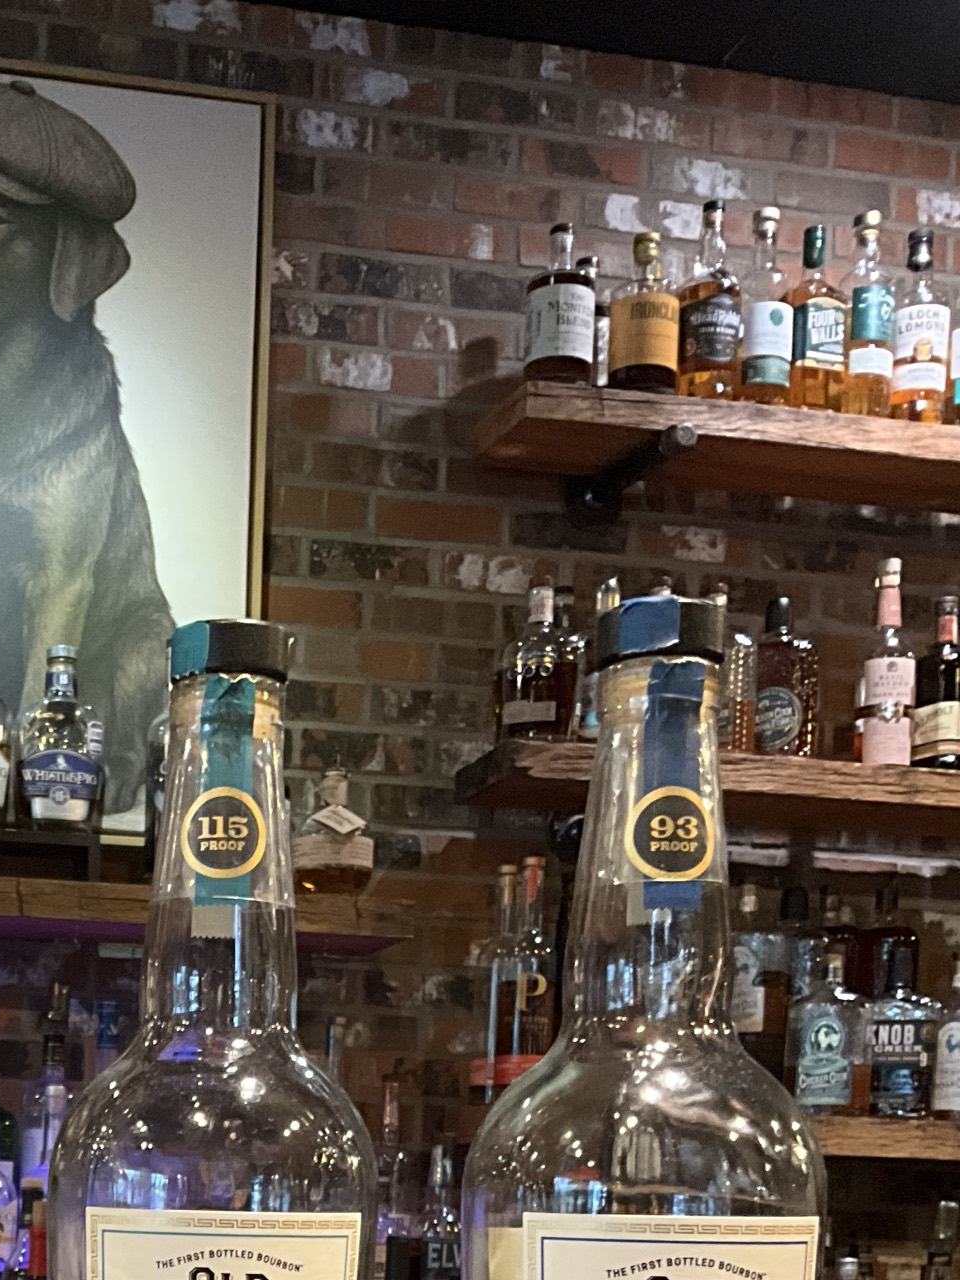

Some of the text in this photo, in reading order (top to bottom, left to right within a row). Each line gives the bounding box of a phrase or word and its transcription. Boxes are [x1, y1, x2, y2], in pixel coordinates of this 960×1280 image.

[548, 301, 595, 316] MONITO
[631, 301, 679, 322] IRONCLA
[809, 309, 836, 327] FOUR
[909, 309, 940, 321] LOCH
[810, 325, 844, 344] WALLS
[196, 815, 248, 840] 115
[650, 816, 698, 840] 93
[199, 839, 246, 852] PROOF
[649, 840, 698, 853] PROOF
[518, 973, 547, 1011] P
[866, 1023, 915, 1045] KNOB
[156, 1259, 175, 1270] THE
[177, 1251, 205, 1266] FIRST
[208, 1249, 254, 1260] BOTTLED
[606, 1268, 627, 1279] THE
[630, 1259, 663, 1275] FIRST
[666, 1257, 715, 1268] BOTTLED
